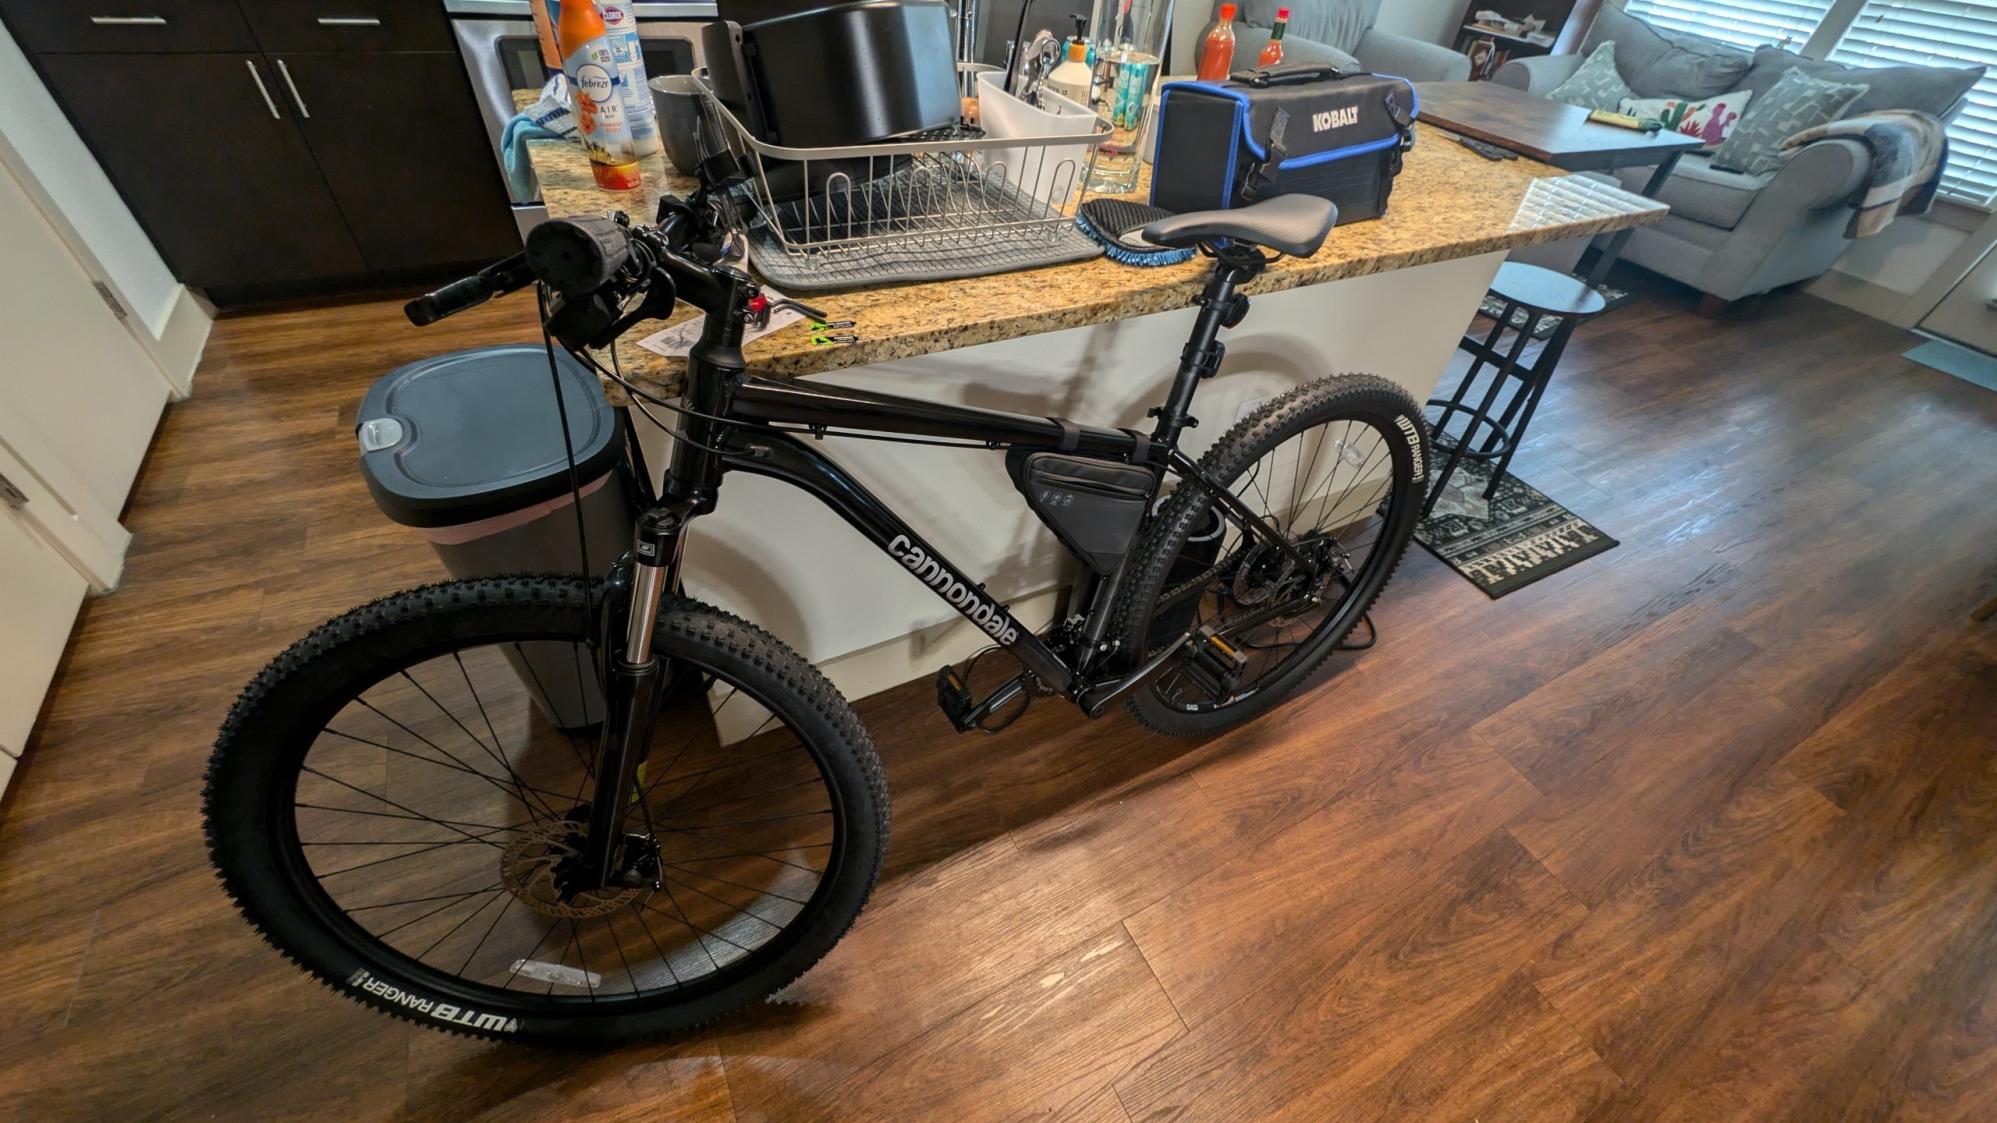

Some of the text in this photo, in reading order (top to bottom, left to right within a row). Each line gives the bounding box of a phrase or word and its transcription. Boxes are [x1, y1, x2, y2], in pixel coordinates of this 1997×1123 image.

[581, 76, 609, 89] febreze
[1312, 106, 1358, 132] KOBALT
[1396, 417, 1420, 445] WTB
[1411, 444, 1423, 475] RANGER
[887, 534, 1018, 646] cannondale
[362, 977, 434, 1013] RANGER
[430, 1003, 507, 1031] WTB
